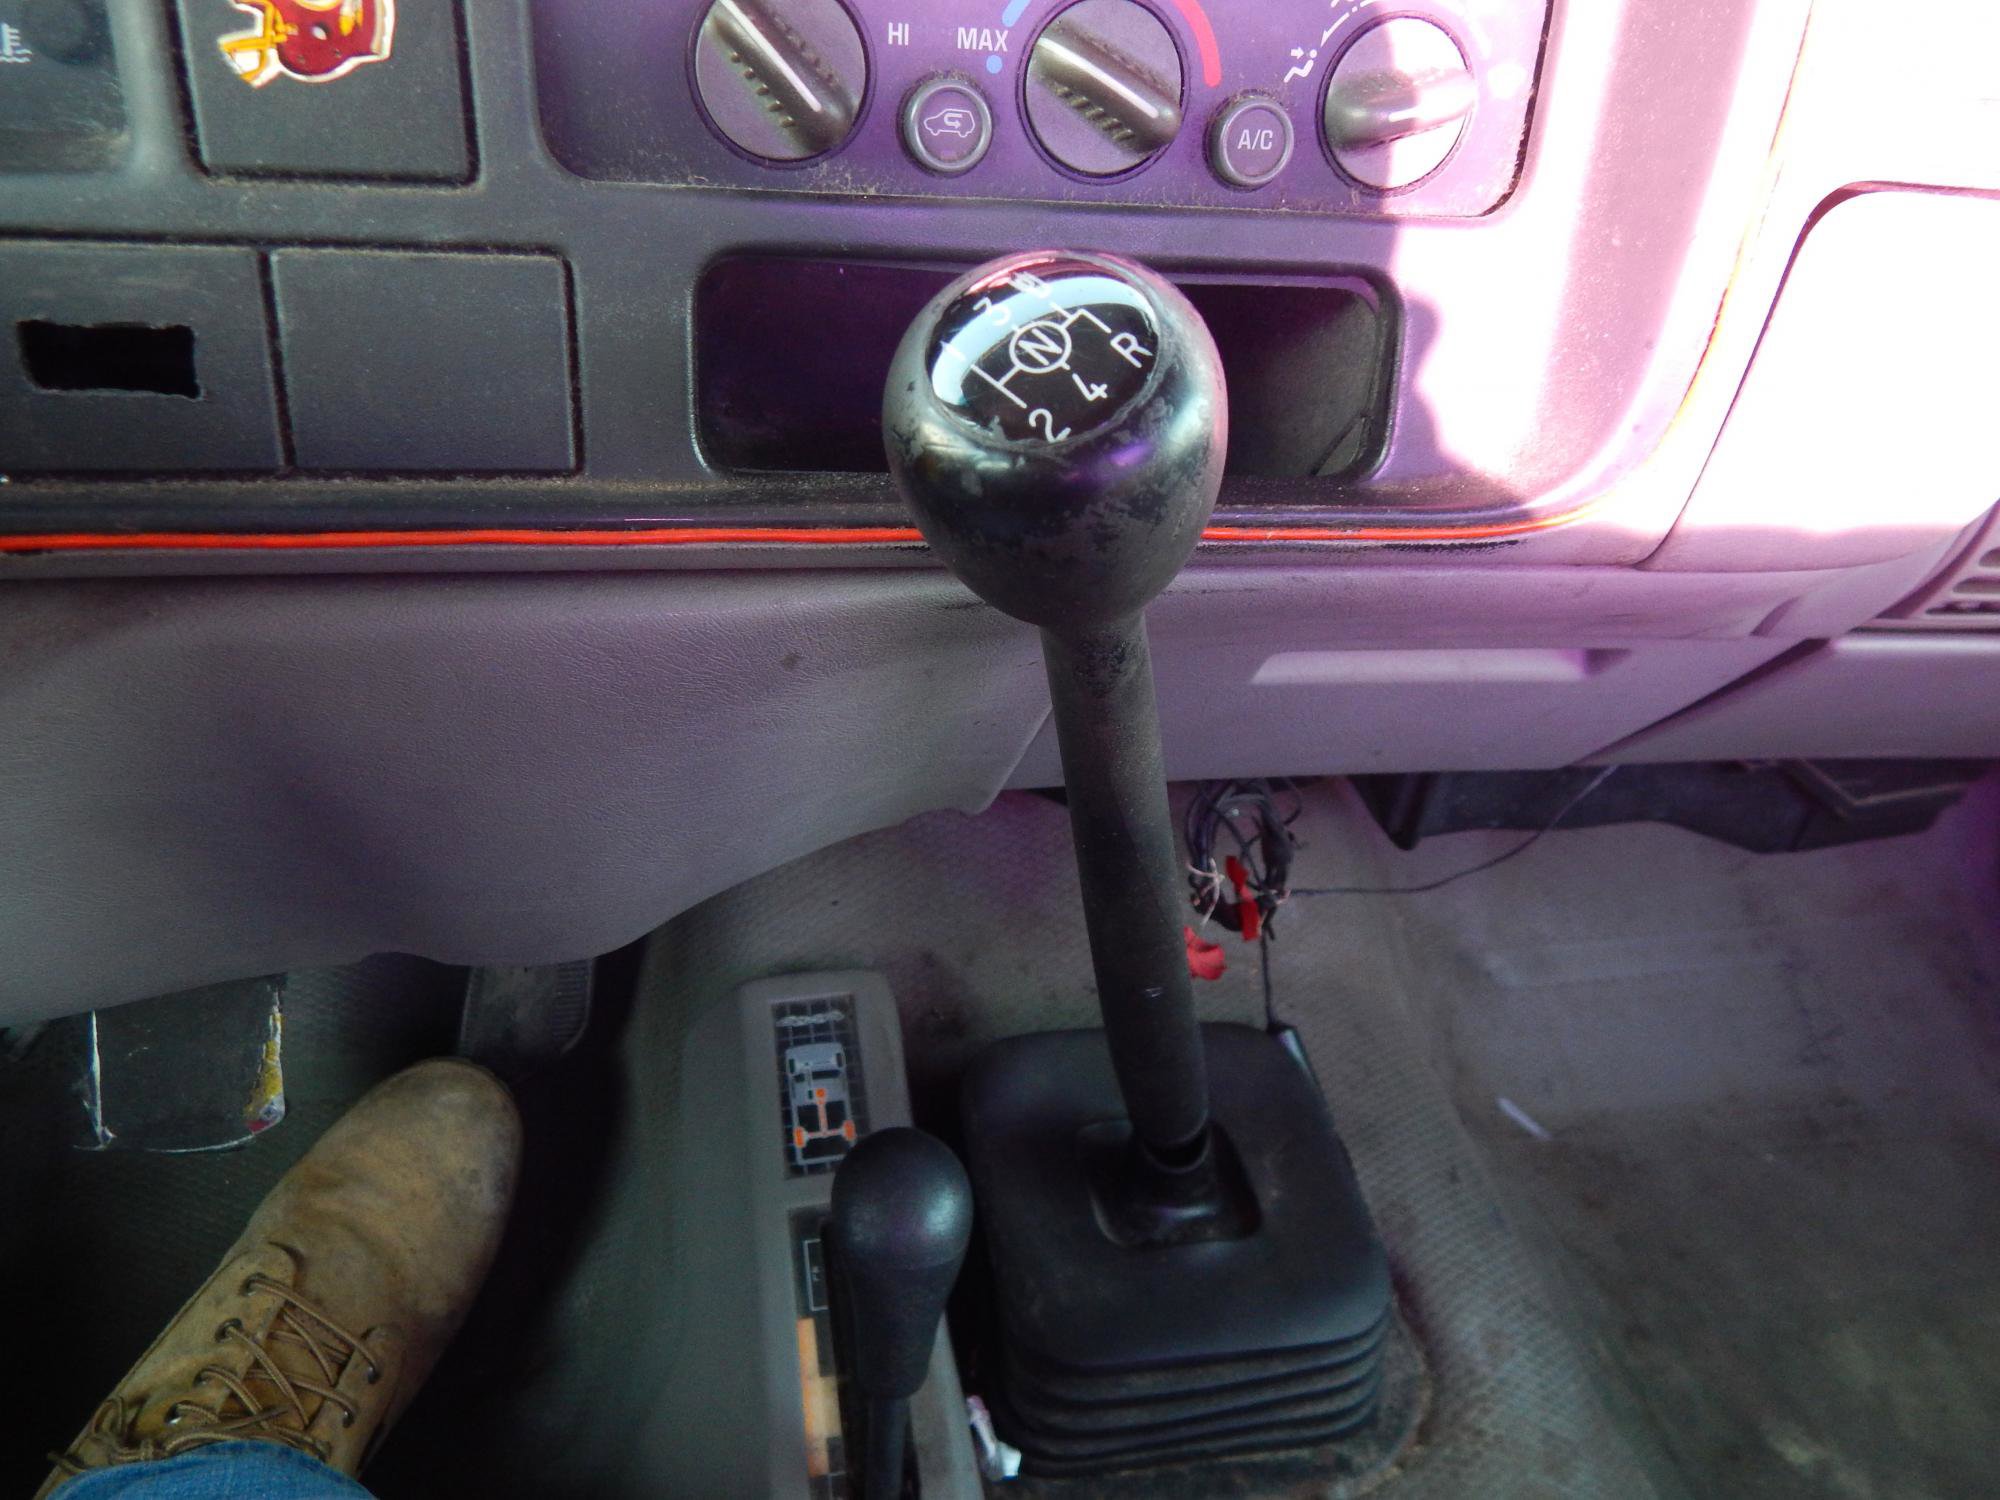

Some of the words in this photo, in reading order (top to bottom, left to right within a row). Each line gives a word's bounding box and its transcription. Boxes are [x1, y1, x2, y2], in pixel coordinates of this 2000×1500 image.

[887, 21, 910, 46] HI
[957, 26, 1009, 52] MAX
[1237, 128, 1274, 151] A/C
[972, 296, 1011, 326] 3
[1018, 327, 1063, 366] N
[1028, 408, 1072, 443] 2
[1071, 372, 1108, 402] 4
[1109, 332, 1154, 369] R
